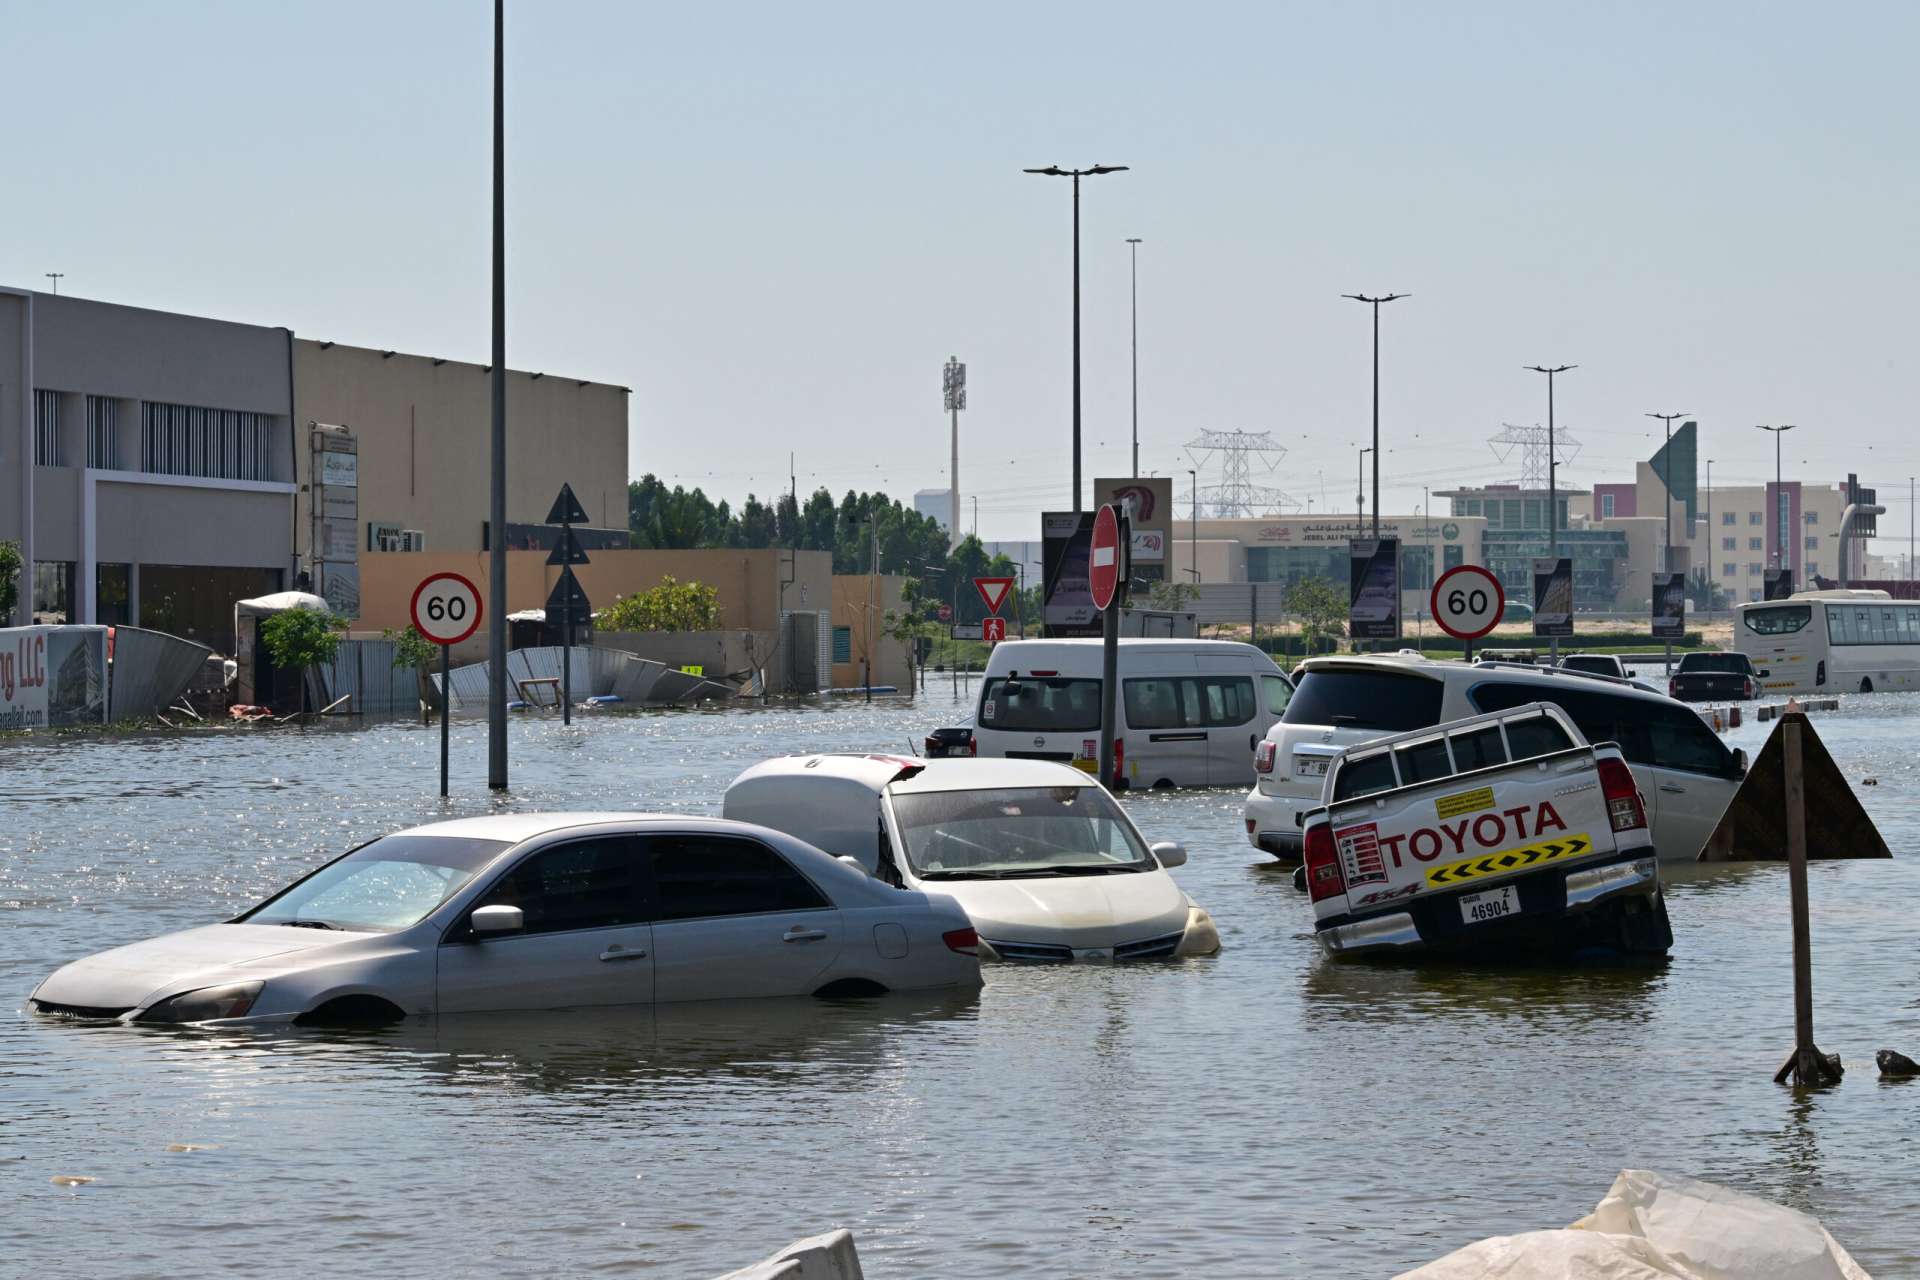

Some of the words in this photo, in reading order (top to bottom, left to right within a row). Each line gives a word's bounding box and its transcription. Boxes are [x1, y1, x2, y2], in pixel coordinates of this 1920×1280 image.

[427, 596, 466, 621] 60
[1448, 589, 1488, 616] 60
[19, 634, 45, 688] LLC
[1378, 800, 1568, 868] TOYOTA
[1501, 887, 1510, 898] Z
[1471, 899, 1510, 921] 46904
